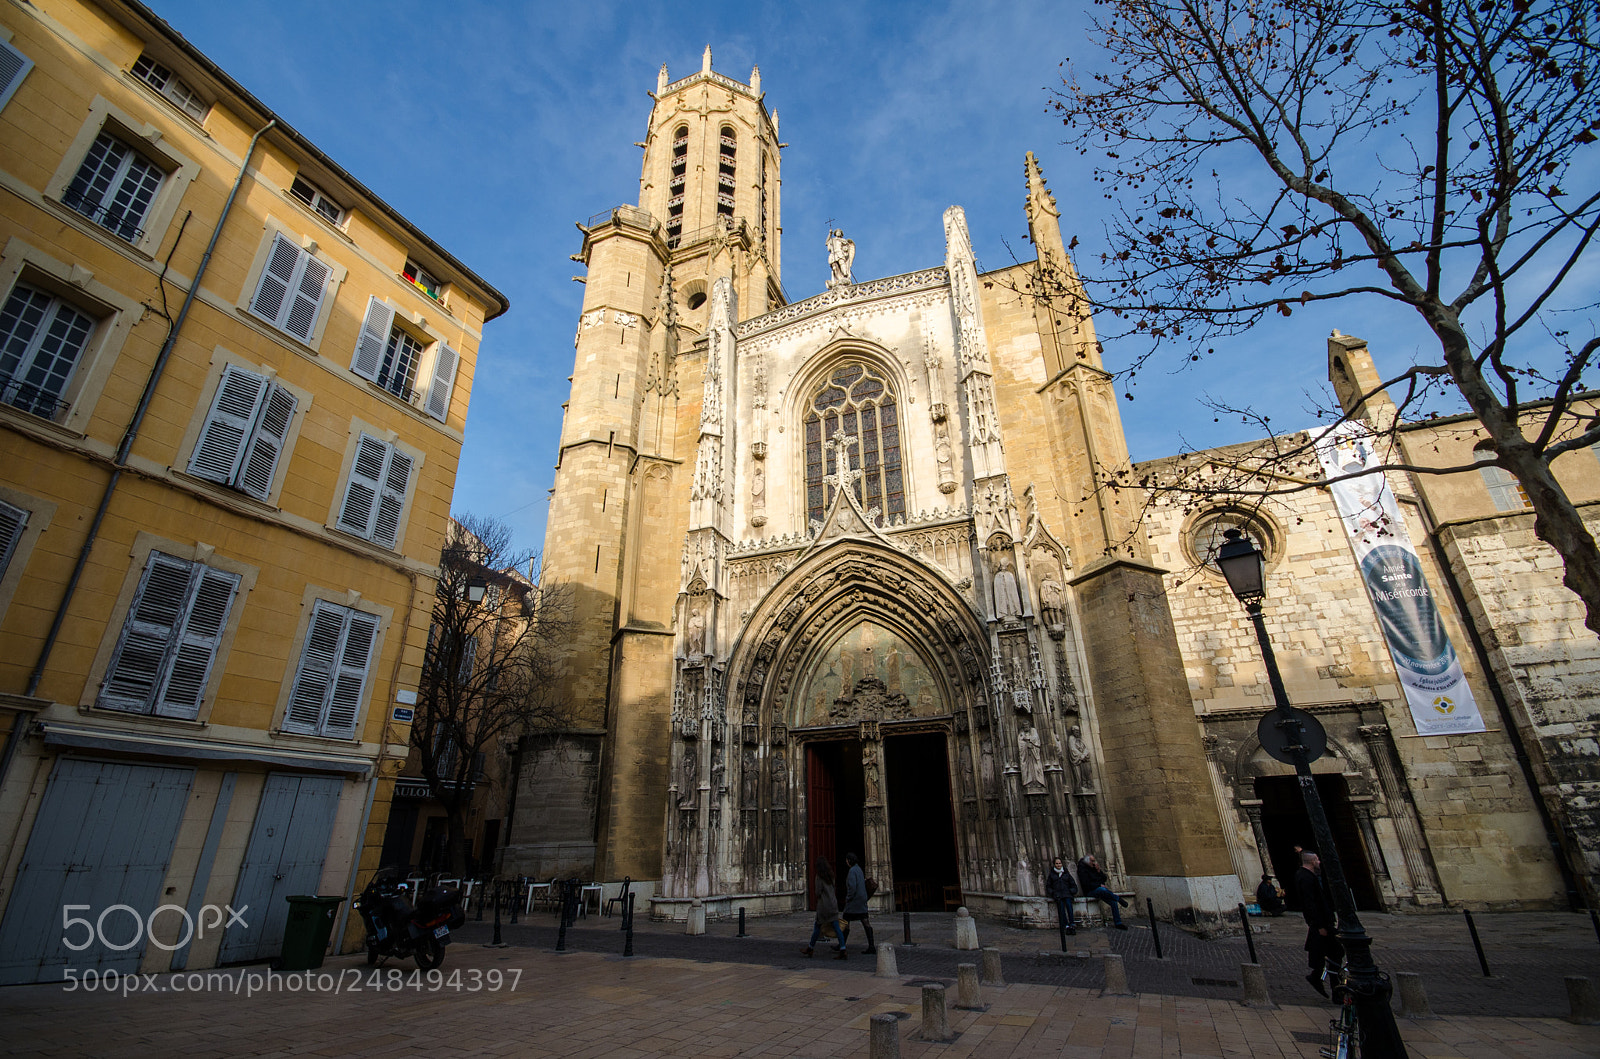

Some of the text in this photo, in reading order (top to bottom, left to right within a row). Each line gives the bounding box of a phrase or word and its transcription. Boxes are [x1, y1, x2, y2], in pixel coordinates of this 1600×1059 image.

[1383, 563, 1406, 574] Année
[1381, 573, 1413, 582] Sainte
[1375, 586, 1429, 602] Miséricorde
[1410, 661, 1441, 670] novembre
